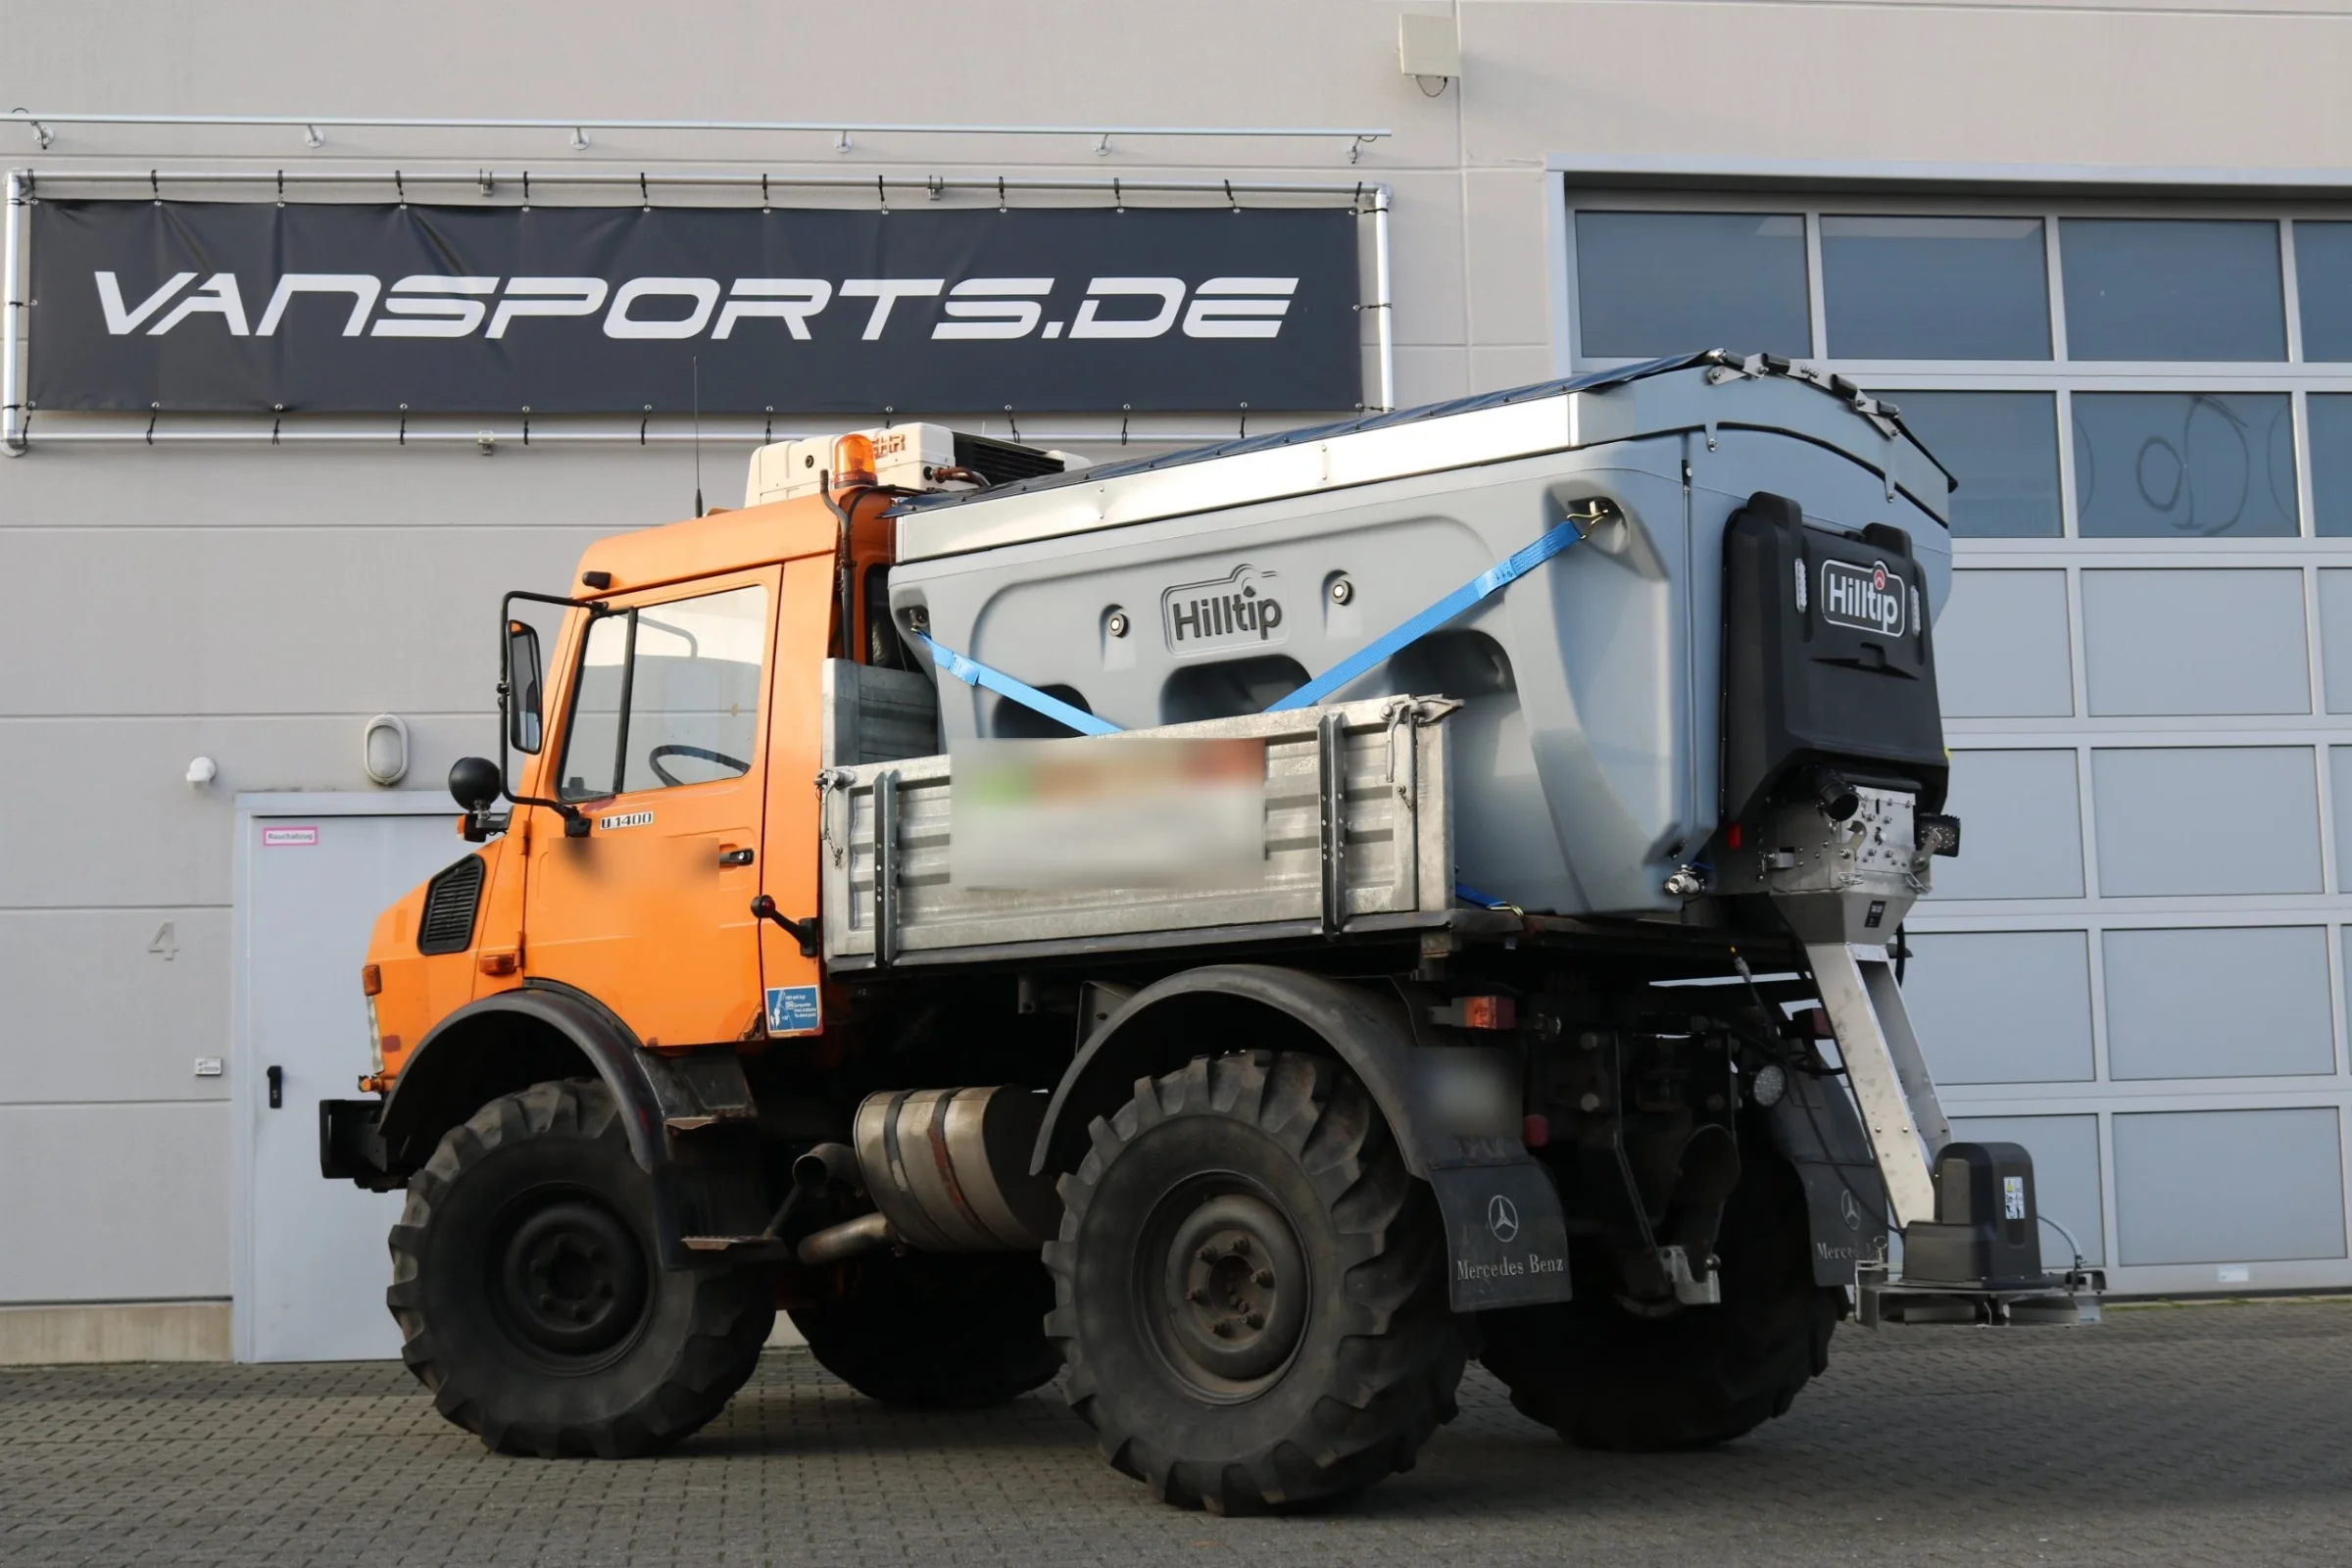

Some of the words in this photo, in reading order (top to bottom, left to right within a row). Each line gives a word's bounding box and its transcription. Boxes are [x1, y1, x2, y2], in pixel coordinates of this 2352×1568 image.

[94, 270, 1299, 340] VANSPORTS.DE
[1172, 586, 1283, 641] Hilltip
[1829, 571, 1898, 633] Hilltip
[601, 817, 611, 829] U
[614, 812, 652, 827] 1400
[148, 921, 179, 961] 4
[1456, 1256, 1524, 1281] Mercedes
[1529, 1253, 1564, 1274] Benz
